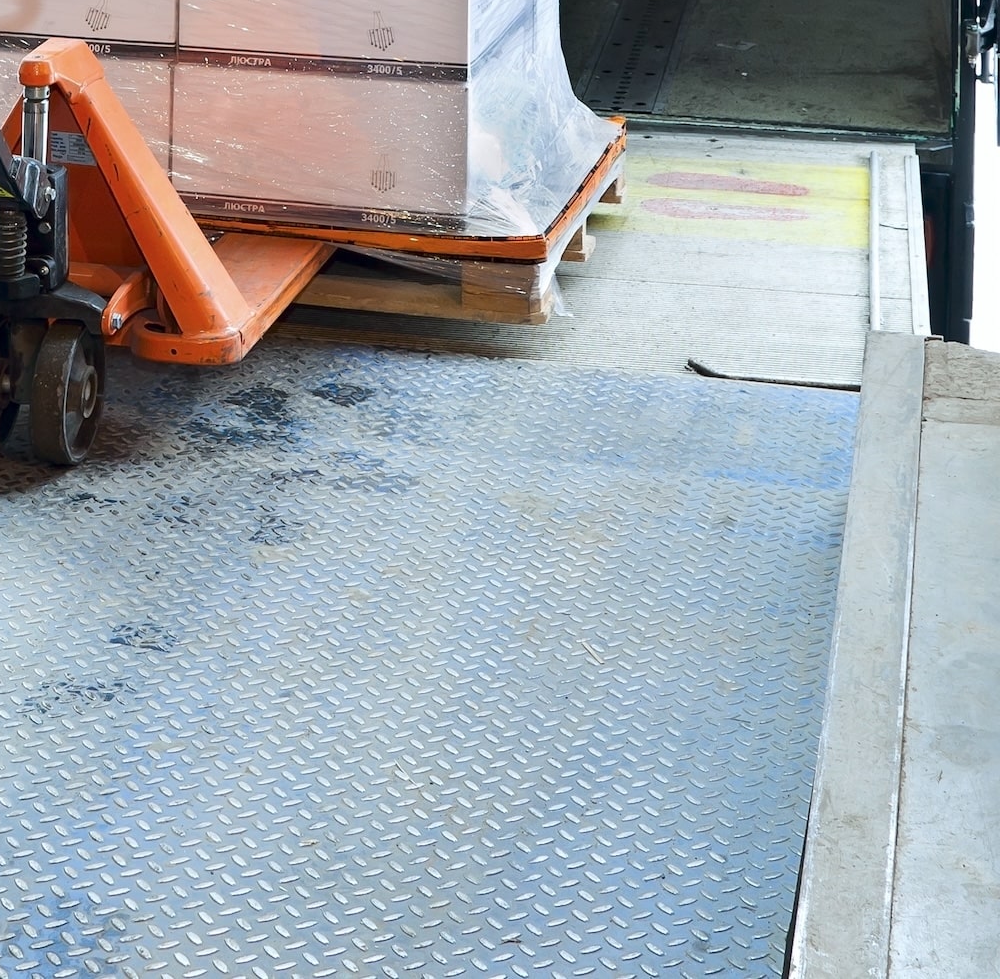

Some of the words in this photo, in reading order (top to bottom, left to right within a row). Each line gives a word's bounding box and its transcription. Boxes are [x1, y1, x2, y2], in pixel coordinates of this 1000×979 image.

[89, 43, 111, 54] 00/5
[230, 55, 272, 67] ЛЮСТРА
[367, 64, 403, 76] 3400/5
[224, 201, 265, 213] ЛЮСТРА
[361, 213, 397, 225] 3400/5
